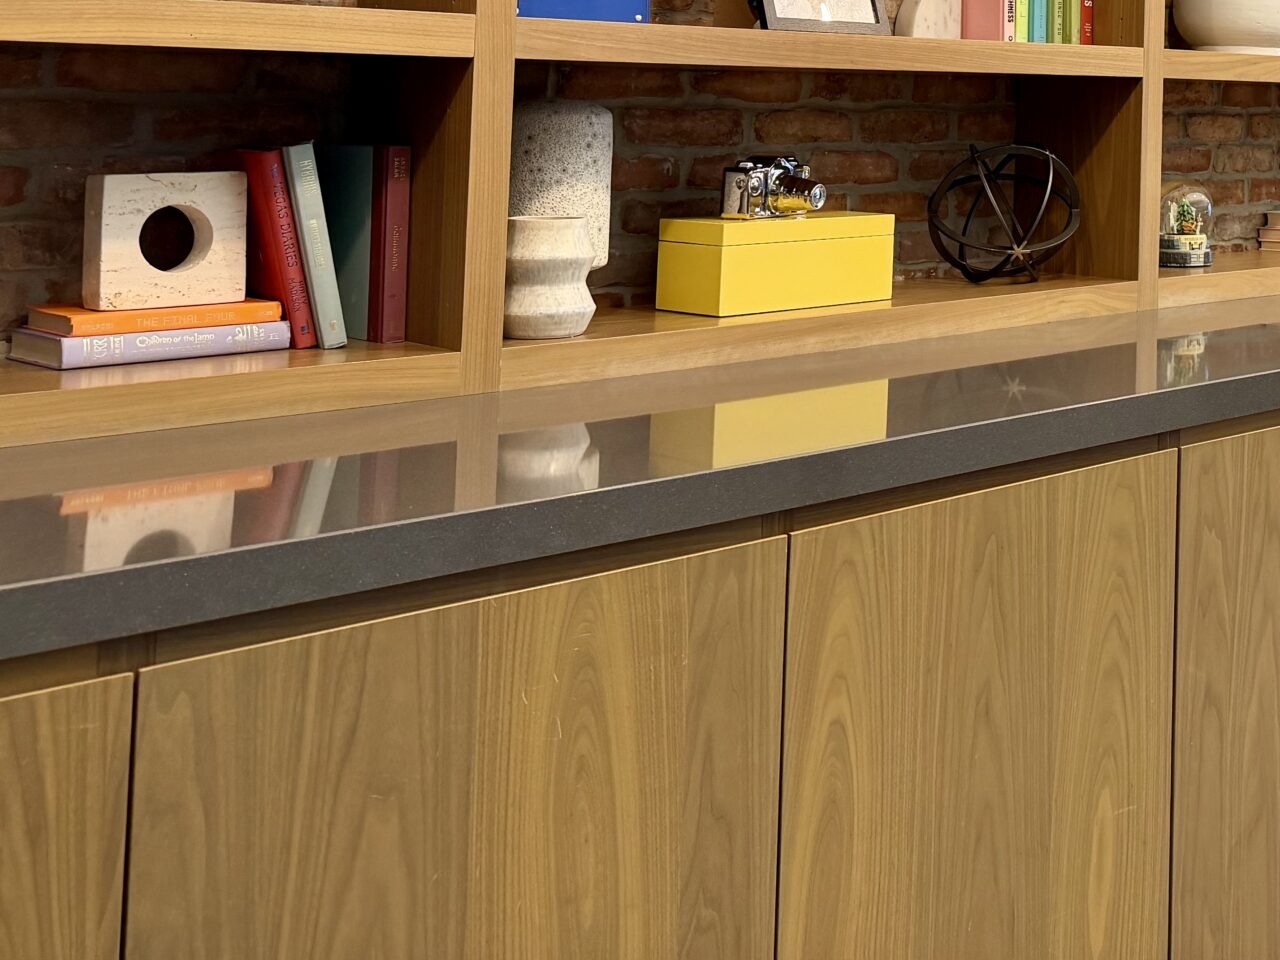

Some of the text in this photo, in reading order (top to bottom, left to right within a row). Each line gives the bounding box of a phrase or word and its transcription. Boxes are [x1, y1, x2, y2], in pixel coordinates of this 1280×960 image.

[274, 182, 289, 219] VEGAS
[280, 223, 298, 268] DIARIES
[289, 278, 302, 312] MADISON
[136, 312, 236, 327] THE FINAL FOUR
[136, 334, 172, 347] Children
